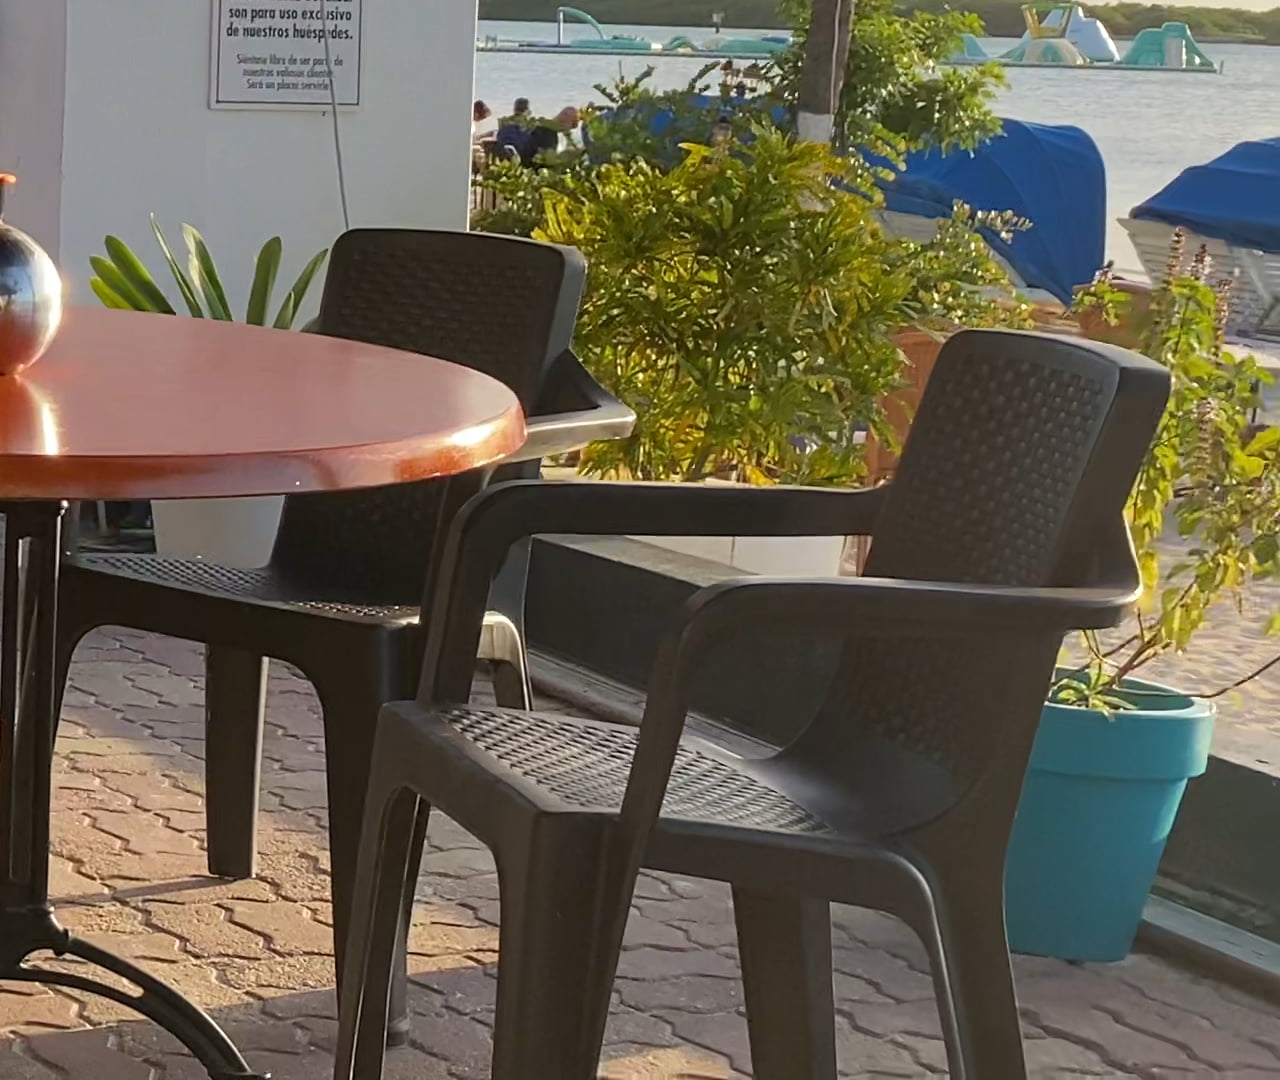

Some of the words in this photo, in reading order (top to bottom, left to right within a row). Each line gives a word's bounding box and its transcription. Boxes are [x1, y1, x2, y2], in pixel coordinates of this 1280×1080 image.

[229, 8, 247, 19] son
[251, 8, 276, 24] para
[279, 10, 298, 20] uso
[301, 6, 352, 21] excsivo
[226, 22, 239, 37] de
[242, 25, 289, 38] nuestros
